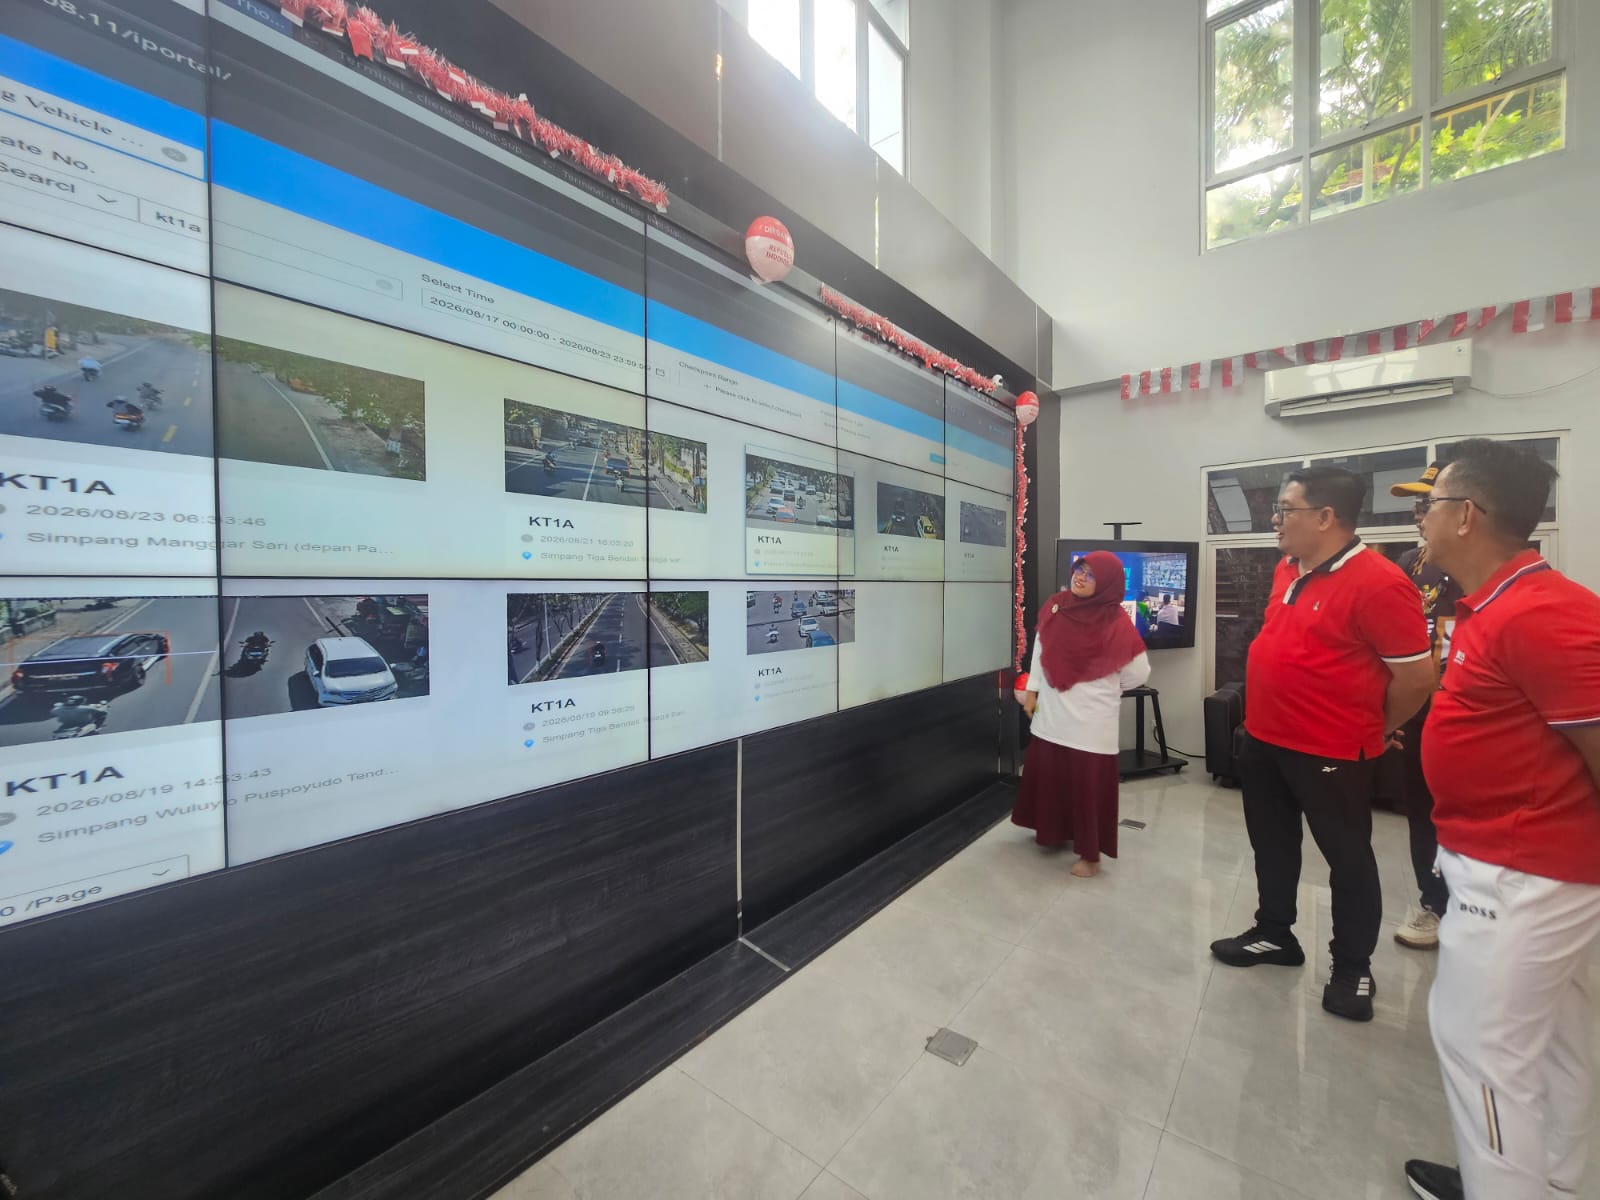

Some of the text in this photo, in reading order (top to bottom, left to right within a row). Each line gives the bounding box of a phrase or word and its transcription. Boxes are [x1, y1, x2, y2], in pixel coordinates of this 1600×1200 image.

[25, 95, 112, 135] Vehicle
[0, 136, 95, 174] ate No.
[156, 211, 201, 233] kt1a
[421, 273, 495, 304] Select Time
[430, 296, 499, 323] 2026/08/17
[502, 319, 550, 340] 00:00:00
[559, 337, 611, 359] 2026/08/23
[0, 472, 115, 496] KT1A
[26, 504, 166, 522] 2026/08/23
[529, 516, 574, 529] KT1A
[27, 532, 139, 548] Simpang
[252, 540, 288, 551] Sari
[294, 542, 352, 553] (depan
[357, 544, 393, 554] Pa...
[757, 535, 782, 545] KT1A
[540, 552, 584, 562] Simpang
[758, 667, 782, 677] KT1A
[531, 698, 576, 713] KT1A
[543, 729, 585, 744] Simpang
[6, 766, 124, 797] KT1A
[37, 784, 173, 816] 2026/08/19
[38, 814, 147, 843] Simpang
[244, 776, 342, 803] Puspoyudo
[347, 768, 399, 782] Tend...
[25, 886, 103, 911] /Page
[1460, 902, 1497, 920] BOSS
